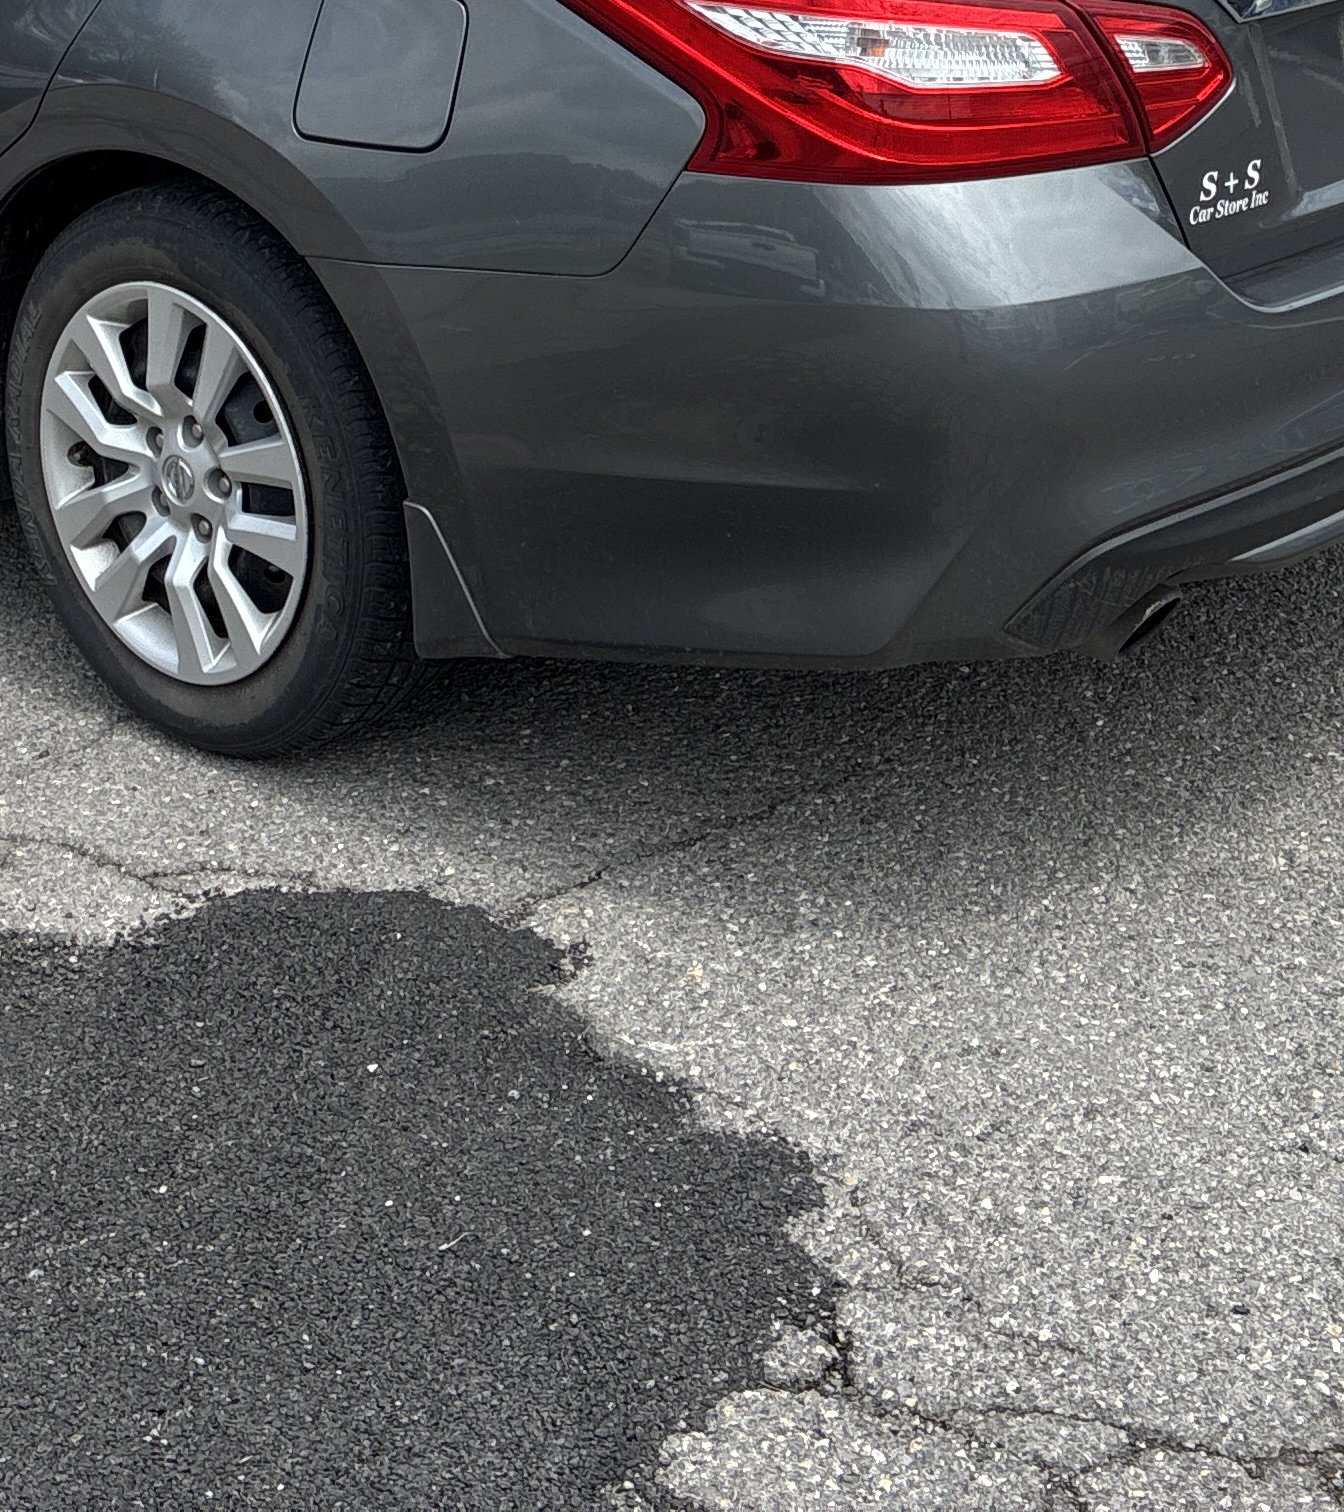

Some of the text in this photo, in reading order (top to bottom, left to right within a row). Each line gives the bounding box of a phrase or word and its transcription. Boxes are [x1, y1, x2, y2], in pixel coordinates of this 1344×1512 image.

[1199, 159, 1262, 202] S + S
[1189, 189, 1269, 225] Car Store Inc
